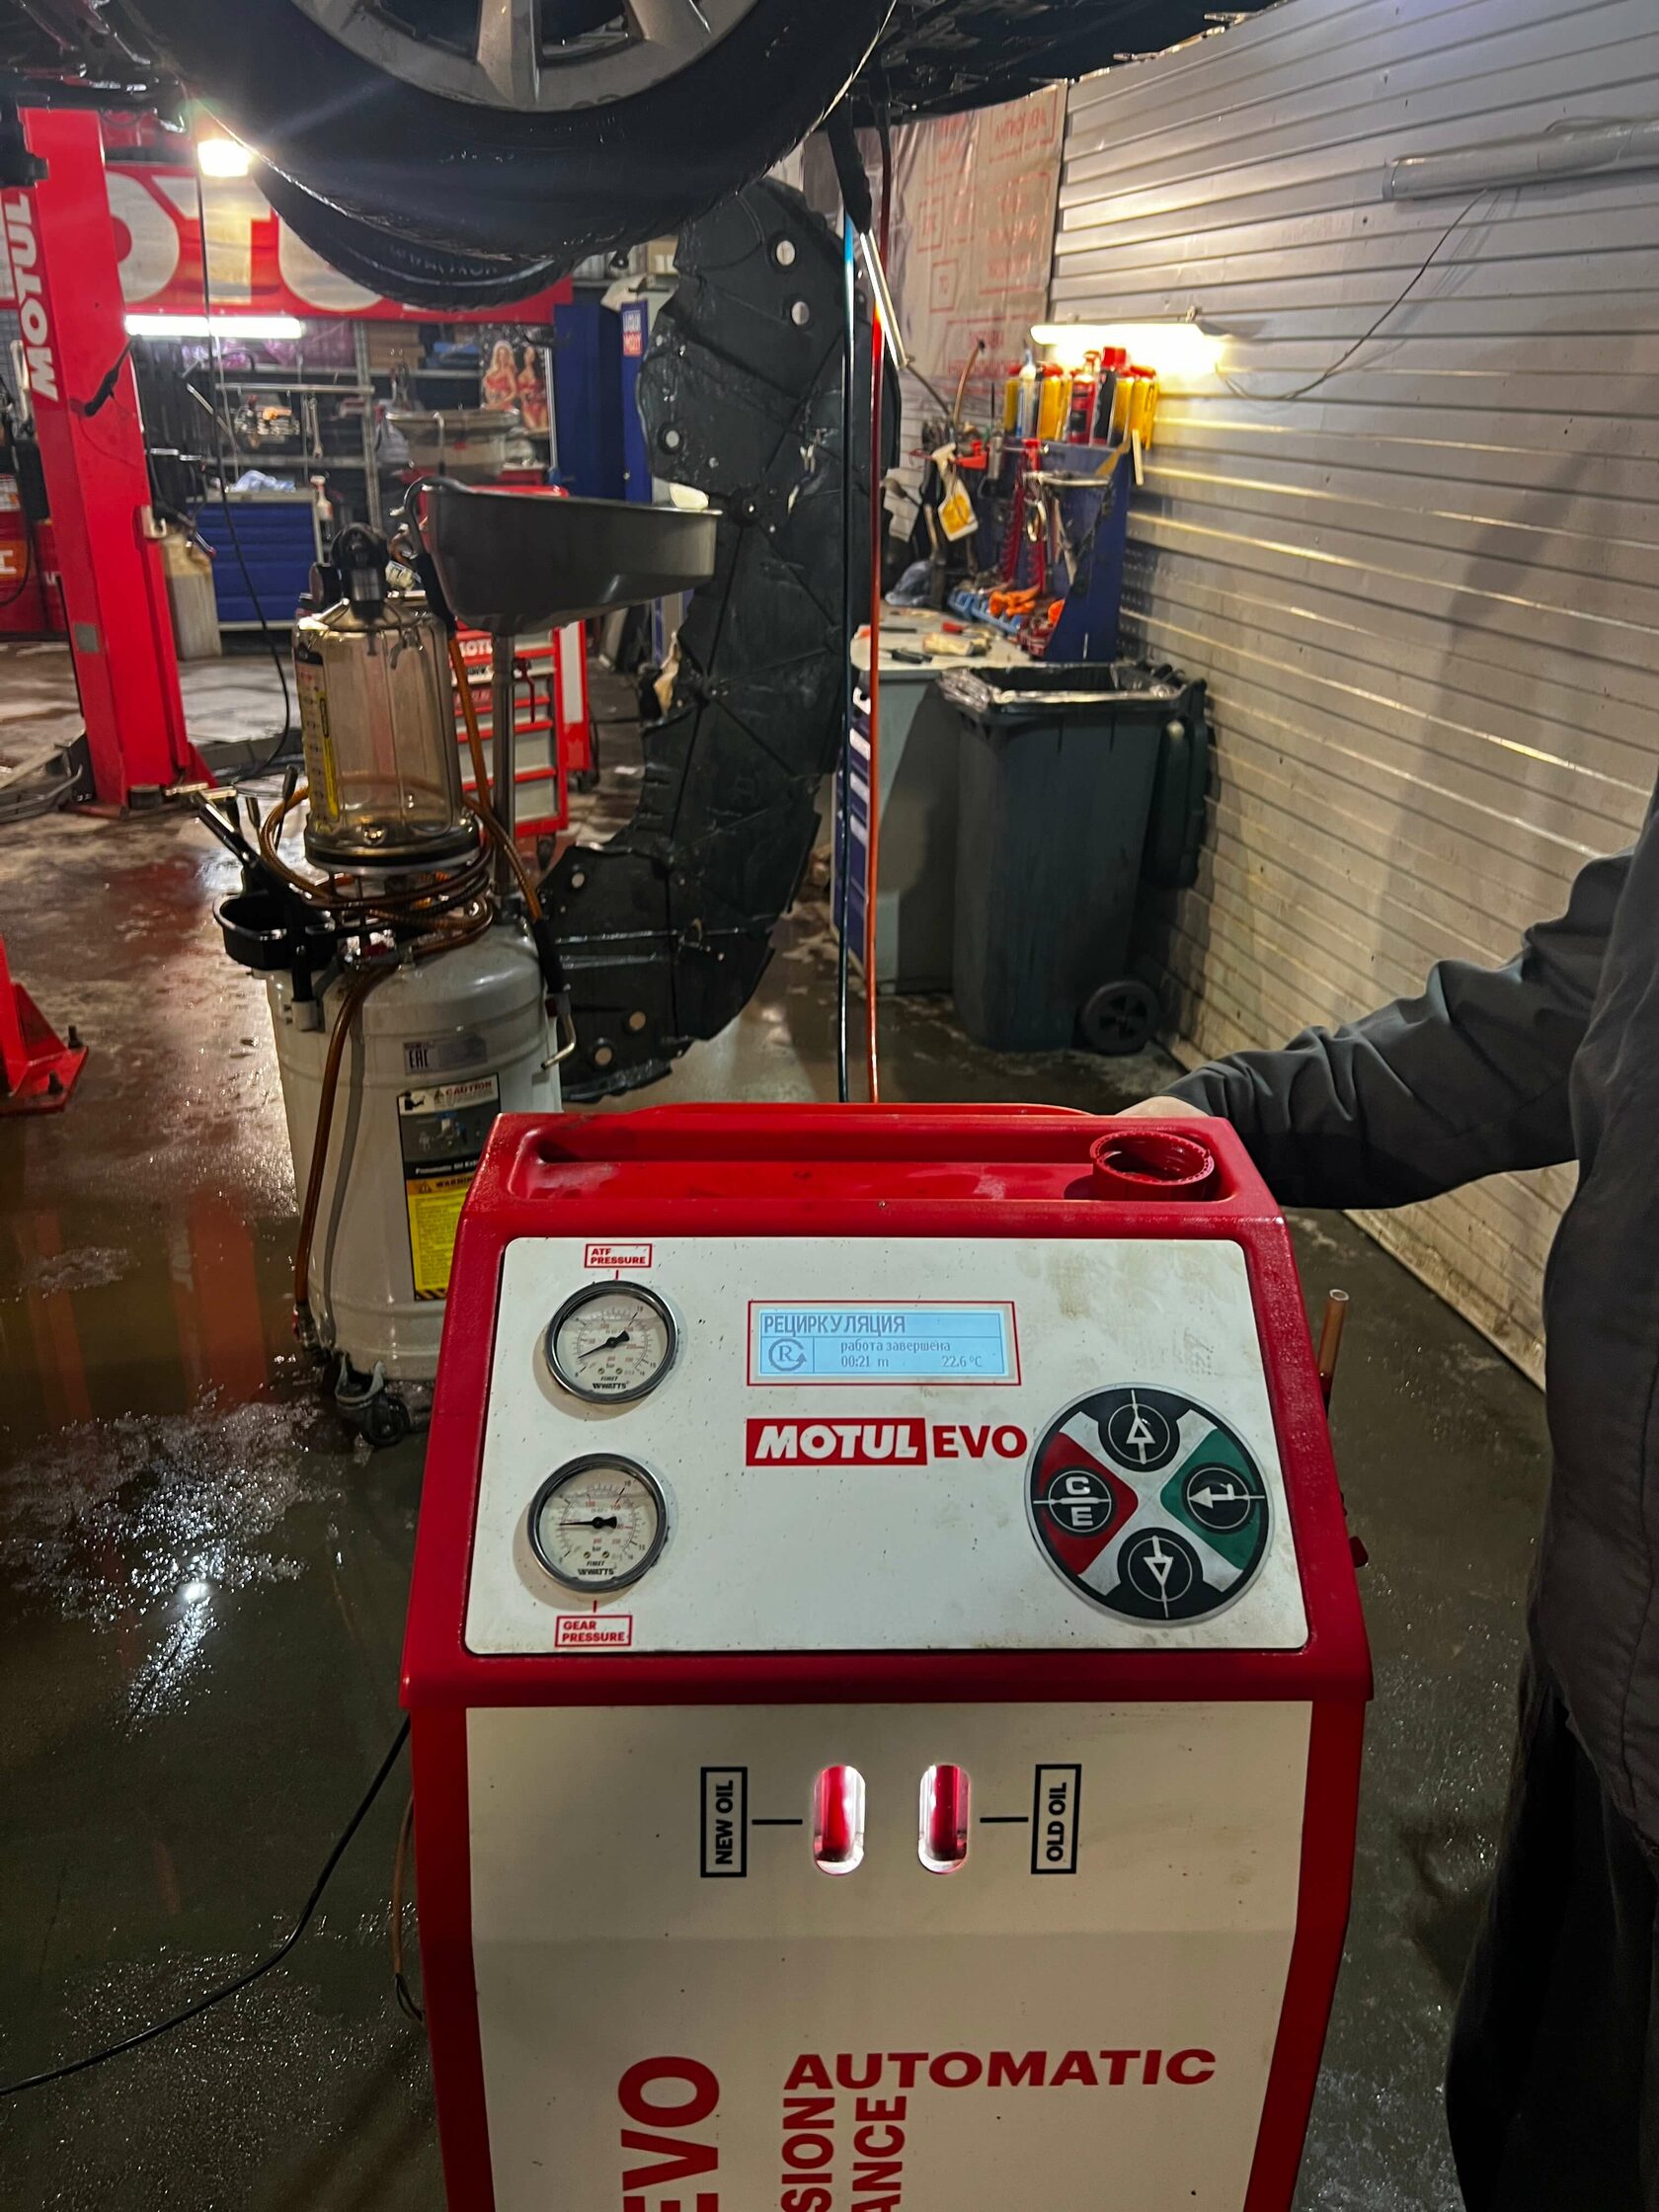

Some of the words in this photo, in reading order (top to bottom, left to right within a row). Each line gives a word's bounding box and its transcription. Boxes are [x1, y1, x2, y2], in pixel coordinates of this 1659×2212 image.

[5, 192, 59, 402] MOTUL
[445, 1079, 492, 1096] CAUTION
[763, 1315, 906, 1337] РЕЦИРКУЛЯЦИЯ
[840, 1339, 883, 1353] работа
[886, 1342, 951, 1353] завершена
[841, 1356, 869, 1368] 00:21
[877, 1359, 889, 1368] m
[941, 1356, 966, 1368] 22.6
[754, 1424, 919, 1460] MOTUL
[932, 1425, 1028, 1459] EVO
[1066, 1476, 1091, 1495] C
[1070, 1506, 1094, 1527] E
[563, 1620, 596, 1630] GEAR
[562, 1631, 625, 1642] PRESSURE
[716, 1780, 733, 1814] OIL
[1049, 1782, 1066, 1815] OIL
[716, 1819, 733, 1864] NEW
[1046, 1821, 1065, 1861] OLD
[784, 2049, 1217, 2091] AUTOMATIC
